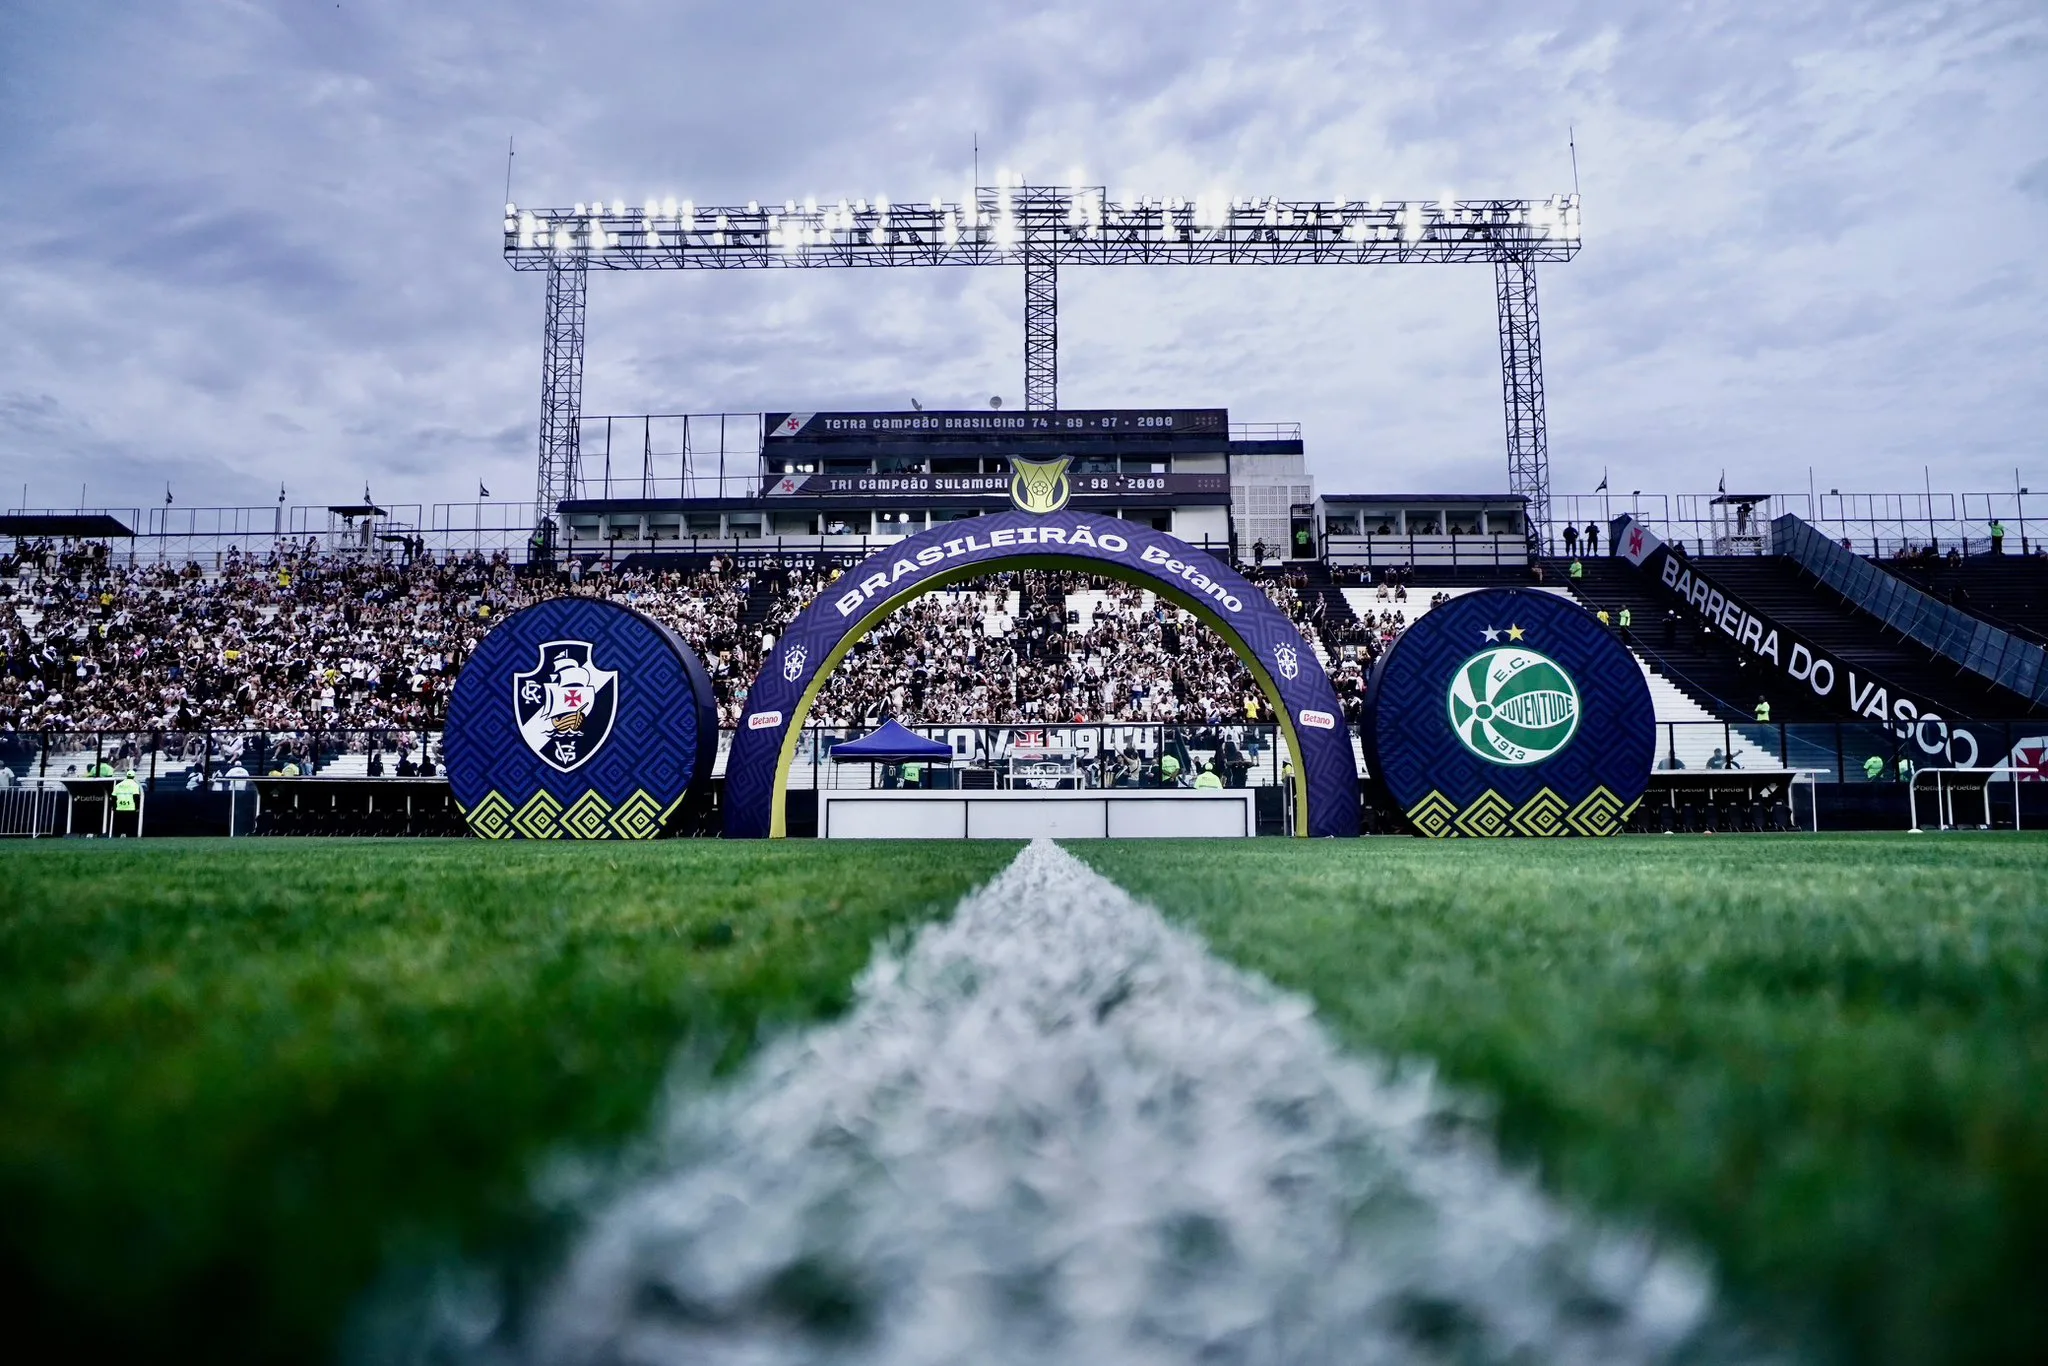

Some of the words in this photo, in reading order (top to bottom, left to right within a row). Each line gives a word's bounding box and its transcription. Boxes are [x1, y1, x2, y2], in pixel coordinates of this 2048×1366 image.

[1031, 418, 1048, 428] 74
[1066, 418, 1083, 428] 89
[1101, 417, 1118, 427] 97
[1137, 416, 1173, 427] 2000
[830, 479, 852, 490] TRI
[1090, 479, 1109, 489] 98
[1127, 478, 1165, 490] 2000
[834, 525, 1128, 617] BRASILEIRÃO
[1140, 545, 1243, 612] Betano
[1493, 657, 1531, 682] E.C.
[1661, 554, 1779, 667] BARREIRA
[1788, 642, 1835, 696] DO
[1849, 671, 1979, 769] VASCO
[752, 715, 778, 726] Betano
[1303, 713, 1331, 725] Betano
[1500, 692, 1574, 726] JUVENTUDE
[1051, 726, 1158, 760] 1944
[1493, 735, 1526, 760] 1913
